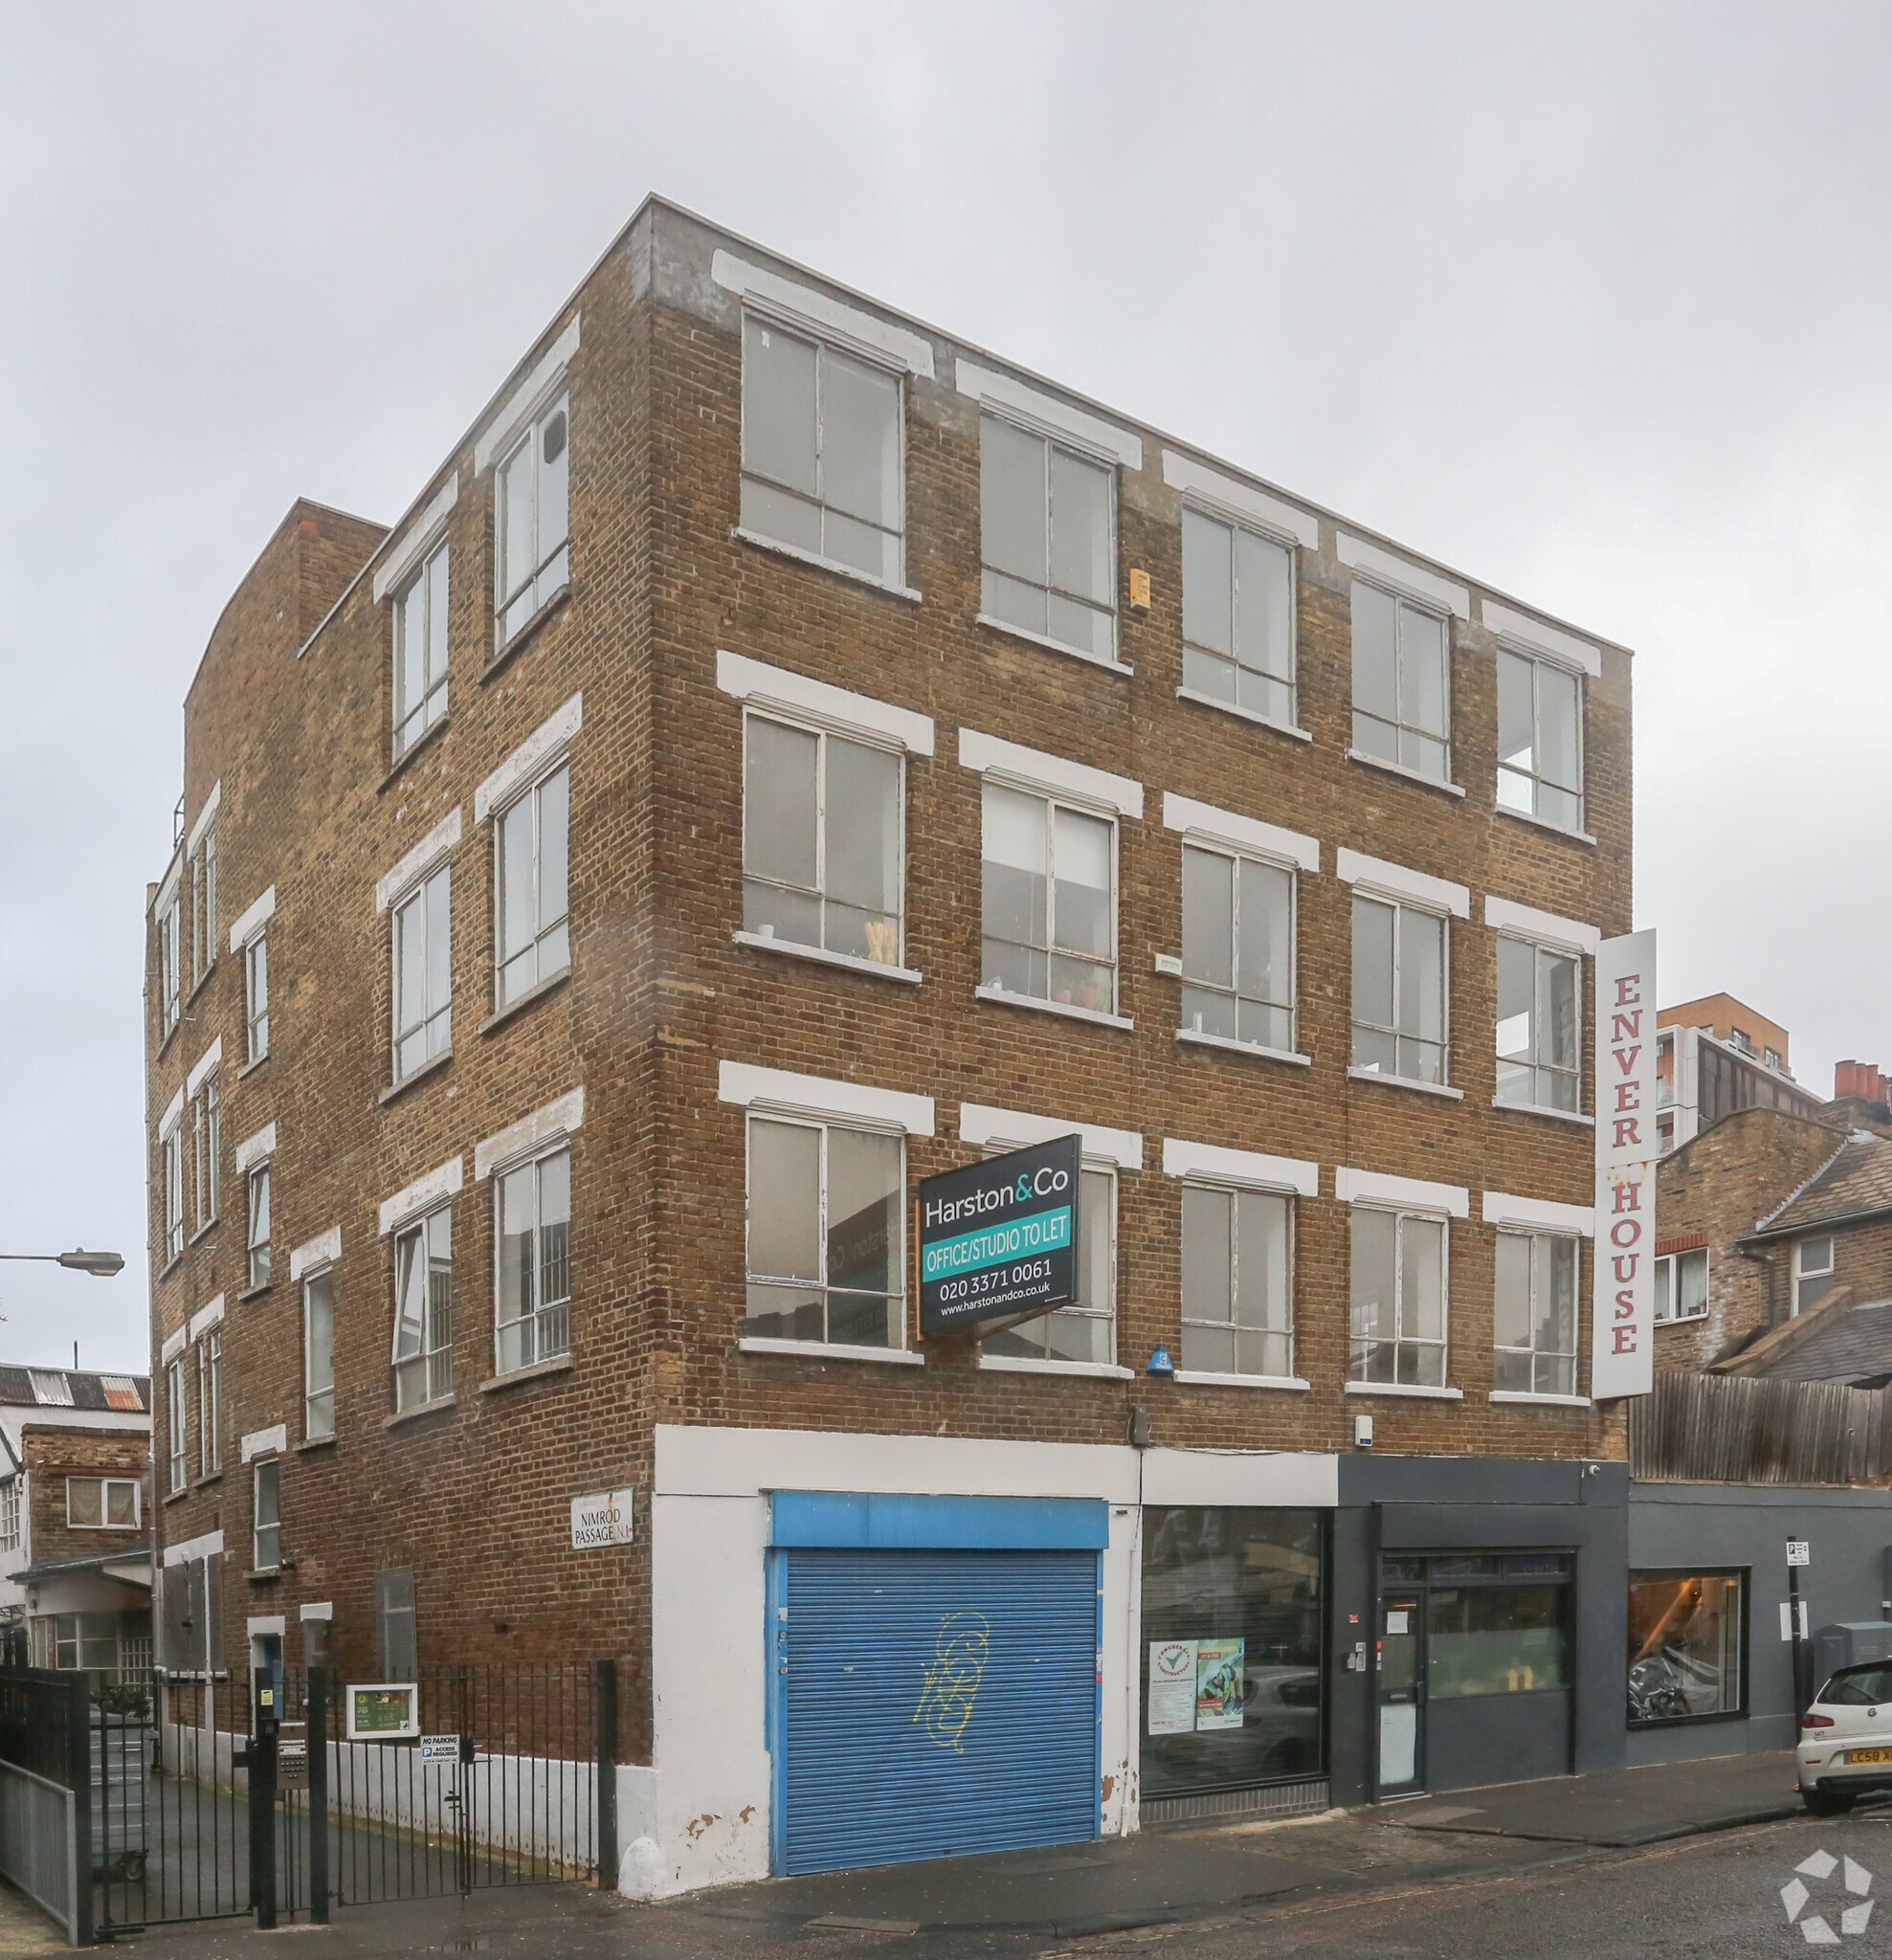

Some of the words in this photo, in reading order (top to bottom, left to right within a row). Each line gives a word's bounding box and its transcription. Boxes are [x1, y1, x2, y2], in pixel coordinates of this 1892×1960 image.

[1612, 974, 1643, 1148] ENVER
[926, 1167, 1069, 1228] Harston&Co
[926, 1228, 1020, 1273] OFFICE/STUDIO
[1022, 1222, 1040, 1247] TO
[1043, 1214, 1067, 1242] LET
[1611, 1182, 1641, 1355] HOUSE
[940, 1281, 968, 1301] 020
[970, 1270, 1009, 1294] 3371
[1013, 1258, 1052, 1283] 0061
[941, 1281, 1050, 1316] www.harstonandco.co.uk
[582, 1508, 621, 1528] NIMROD
[1850, 1751, 1880, 1763] LC58
